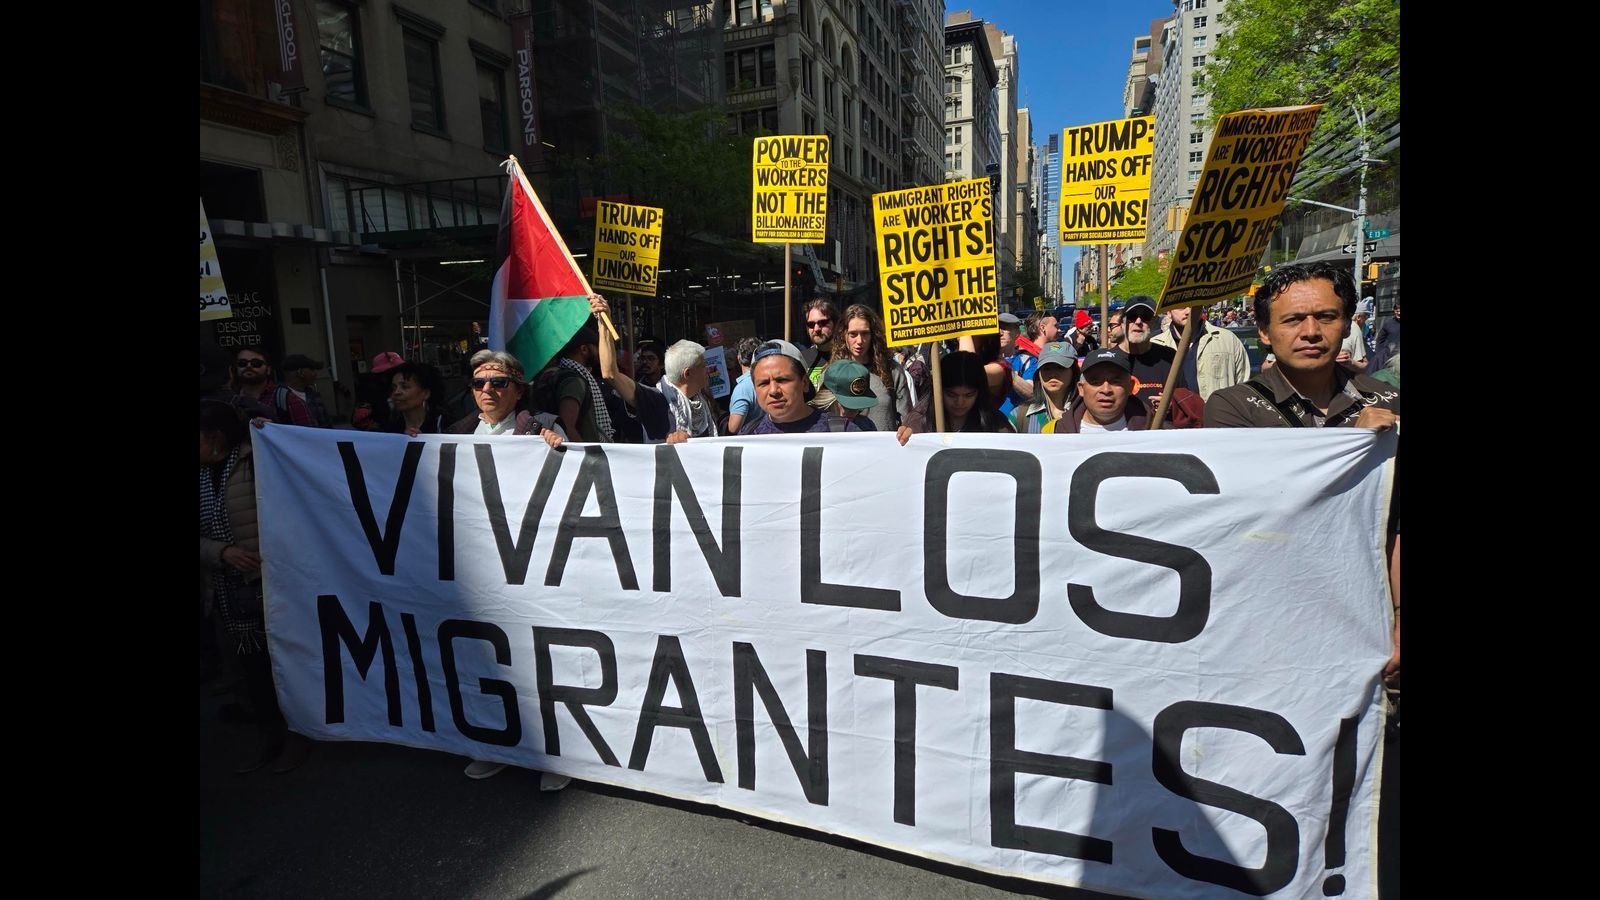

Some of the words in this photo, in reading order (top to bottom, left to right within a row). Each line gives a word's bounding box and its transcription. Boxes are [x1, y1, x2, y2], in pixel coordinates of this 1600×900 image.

[280, 0, 297, 71] CHOOL
[517, 49, 537, 146] PARSONS
[1219, 114, 1289, 137] IMMIGRANT
[1289, 111, 1319, 132] RIGHTS
[757, 138, 828, 163] POWER
[1069, 119, 1154, 157] TRUMP:
[1212, 146, 1231, 162] ARE
[1231, 133, 1310, 164] WORKER'S
[757, 168, 827, 187] WORKERS
[790, 160, 801, 168] THE
[1066, 158, 1117, 183] HANDS
[1121, 154, 1152, 177] OFF
[879, 188, 943, 211] IMMIGRANT
[947, 181, 990, 201] RIGHTS
[1094, 185, 1116, 200] OUR
[1195, 161, 1298, 215] RIGHTS!
[601, 203, 662, 229] TRUMP:
[757, 192, 787, 214] NOT
[794, 192, 826, 214] THE
[882, 214, 901, 228] ARE
[903, 198, 991, 228] WORKER'S
[1064, 199, 1148, 229] UNIONS!
[756, 215, 825, 229] BILLIONAIRES!
[1064, 232, 1079, 240] PARTY
[1088, 231, 1112, 239] SOCIALISM
[599, 228, 638, 246] HANDS
[639, 233, 660, 250] OFF
[883, 220, 992, 268] RIGHTS!
[1179, 218, 1249, 263] STOP
[619, 250, 636, 262] OUR
[597, 258, 657, 284] UNIONS!
[886, 267, 948, 305] STOP
[954, 265, 996, 296] THE
[890, 295, 997, 326] DEPORTATIONS!
[217, 321, 257, 333] DESIGN
[219, 335, 261, 346] CENTER
[893, 327, 913, 339] PARTY
[913, 326, 926, 336] FOR
[926, 322, 956, 335] SOCIALISM
[961, 317, 997, 329] LIBERATION
[337, 441, 743, 597] VIVAN
[800, 446, 1221, 643] LOS
[316, 594, 1359, 898] MIGRANTES!
